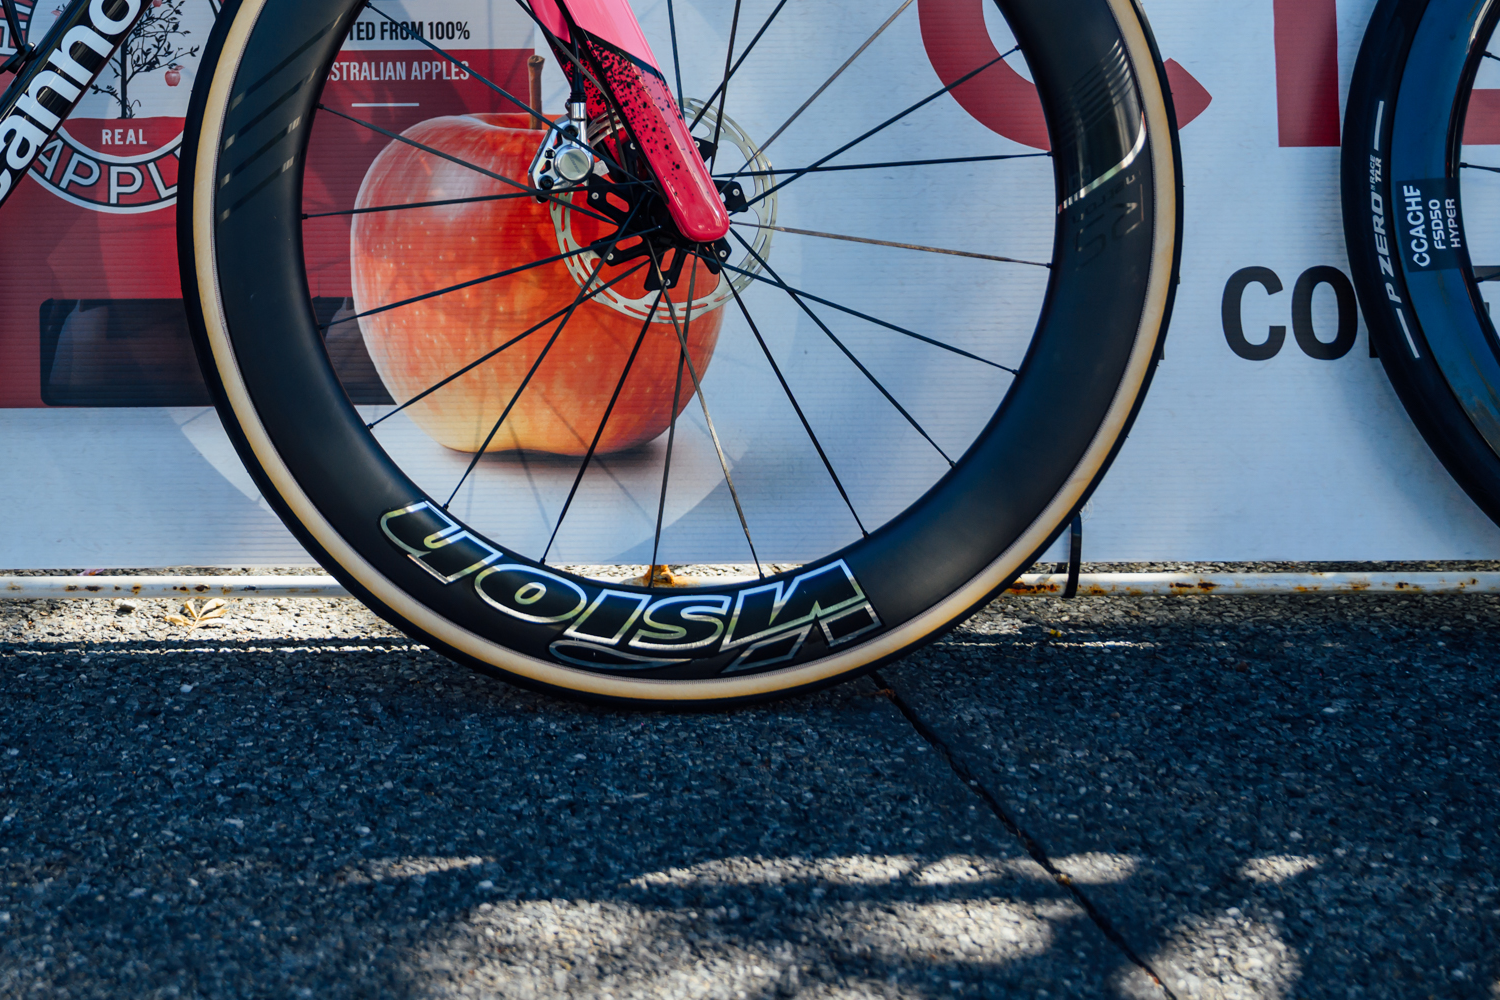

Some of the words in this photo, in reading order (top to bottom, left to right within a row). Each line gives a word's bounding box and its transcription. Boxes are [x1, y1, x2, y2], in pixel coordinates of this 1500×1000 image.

[380, 21, 424, 41] FROM
[428, 21, 470, 40] 100%
[327, 62, 406, 82] STRALIAN
[410, 61, 470, 81] APPLES
[101, 128, 148, 146] REAL
[1374, 156, 1383, 183] TLR
[1370, 191, 1395, 279] ZERO
[1428, 199, 1446, 250] FSD50
[1445, 198, 1461, 248] HYPER
[1385, 282, 1402, 304] P
